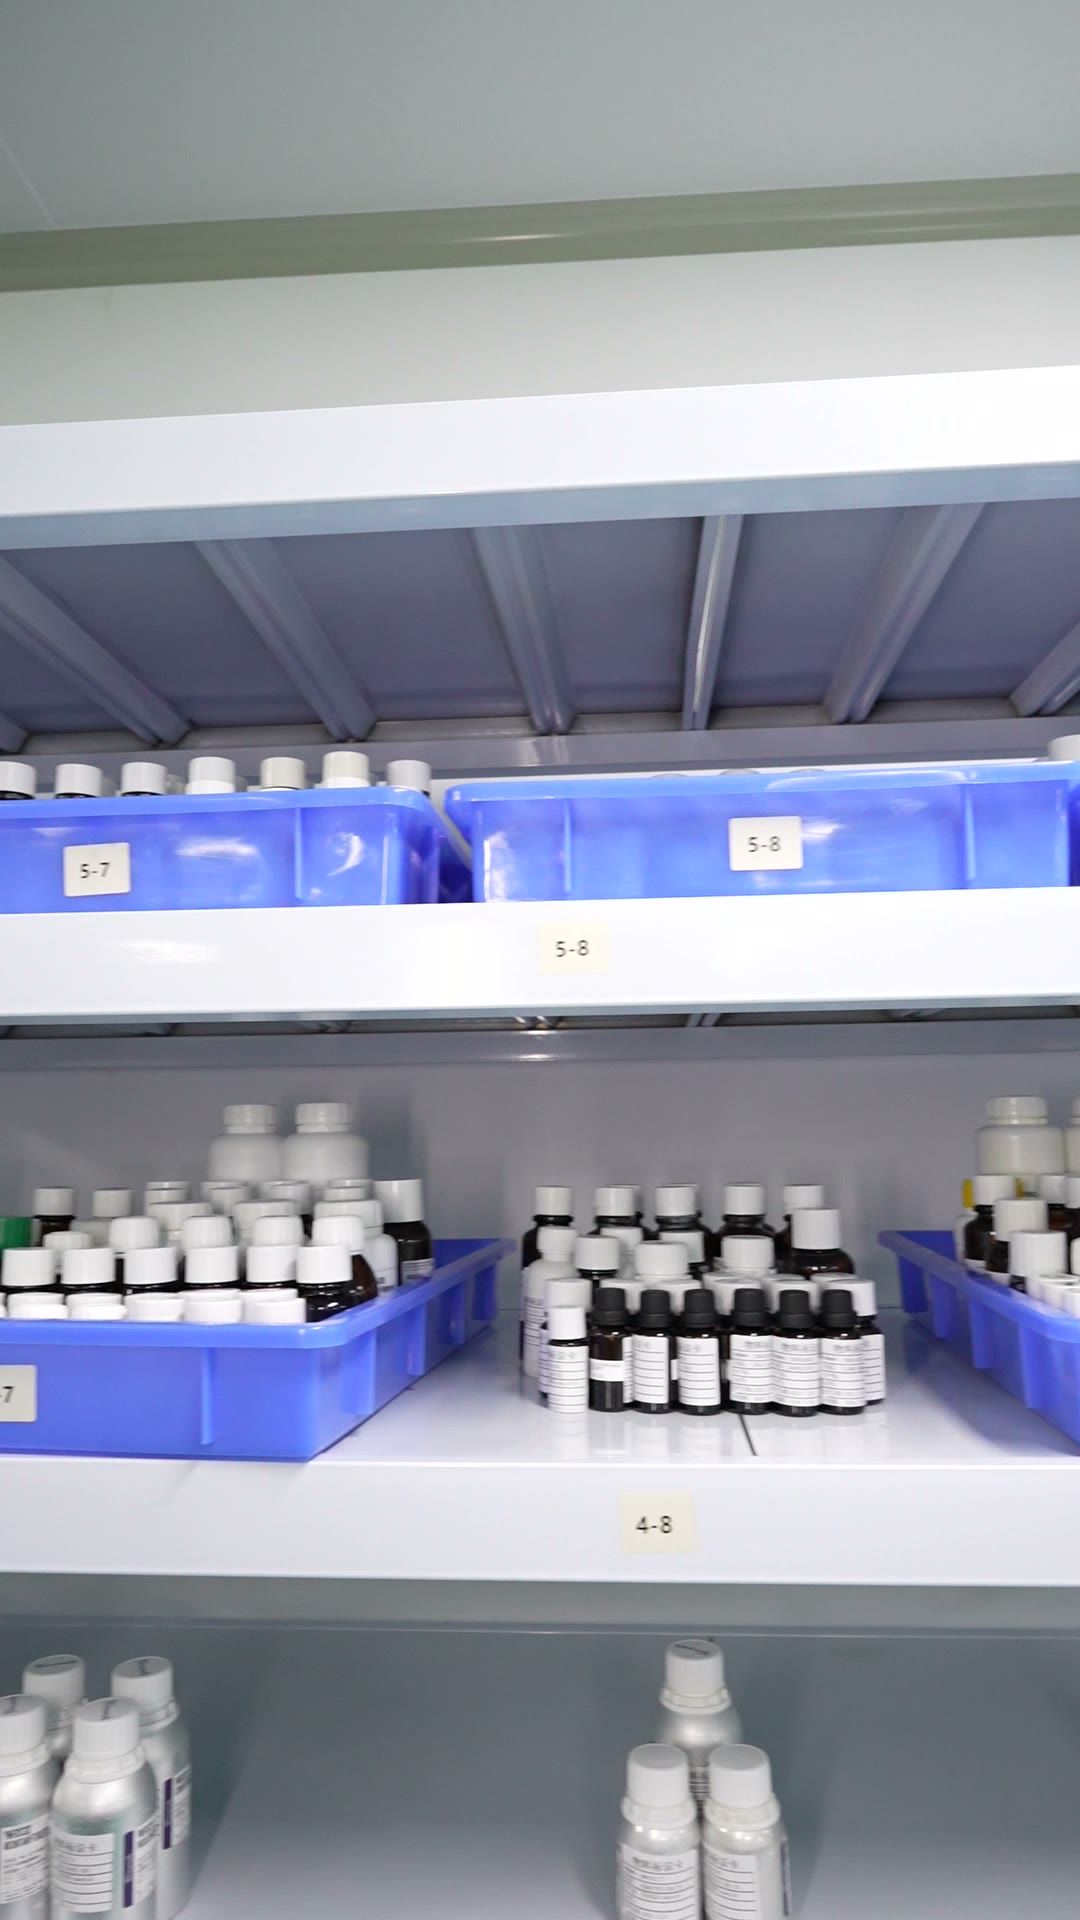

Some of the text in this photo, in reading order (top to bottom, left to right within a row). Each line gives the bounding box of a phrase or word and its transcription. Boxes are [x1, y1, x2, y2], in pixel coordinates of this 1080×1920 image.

[748, 835, 780, 853] 5-8
[80, 861, 110, 879] 5-7
[556, 940, 590, 959] 5-8
[635, 1515, 674, 1535] 4-8
